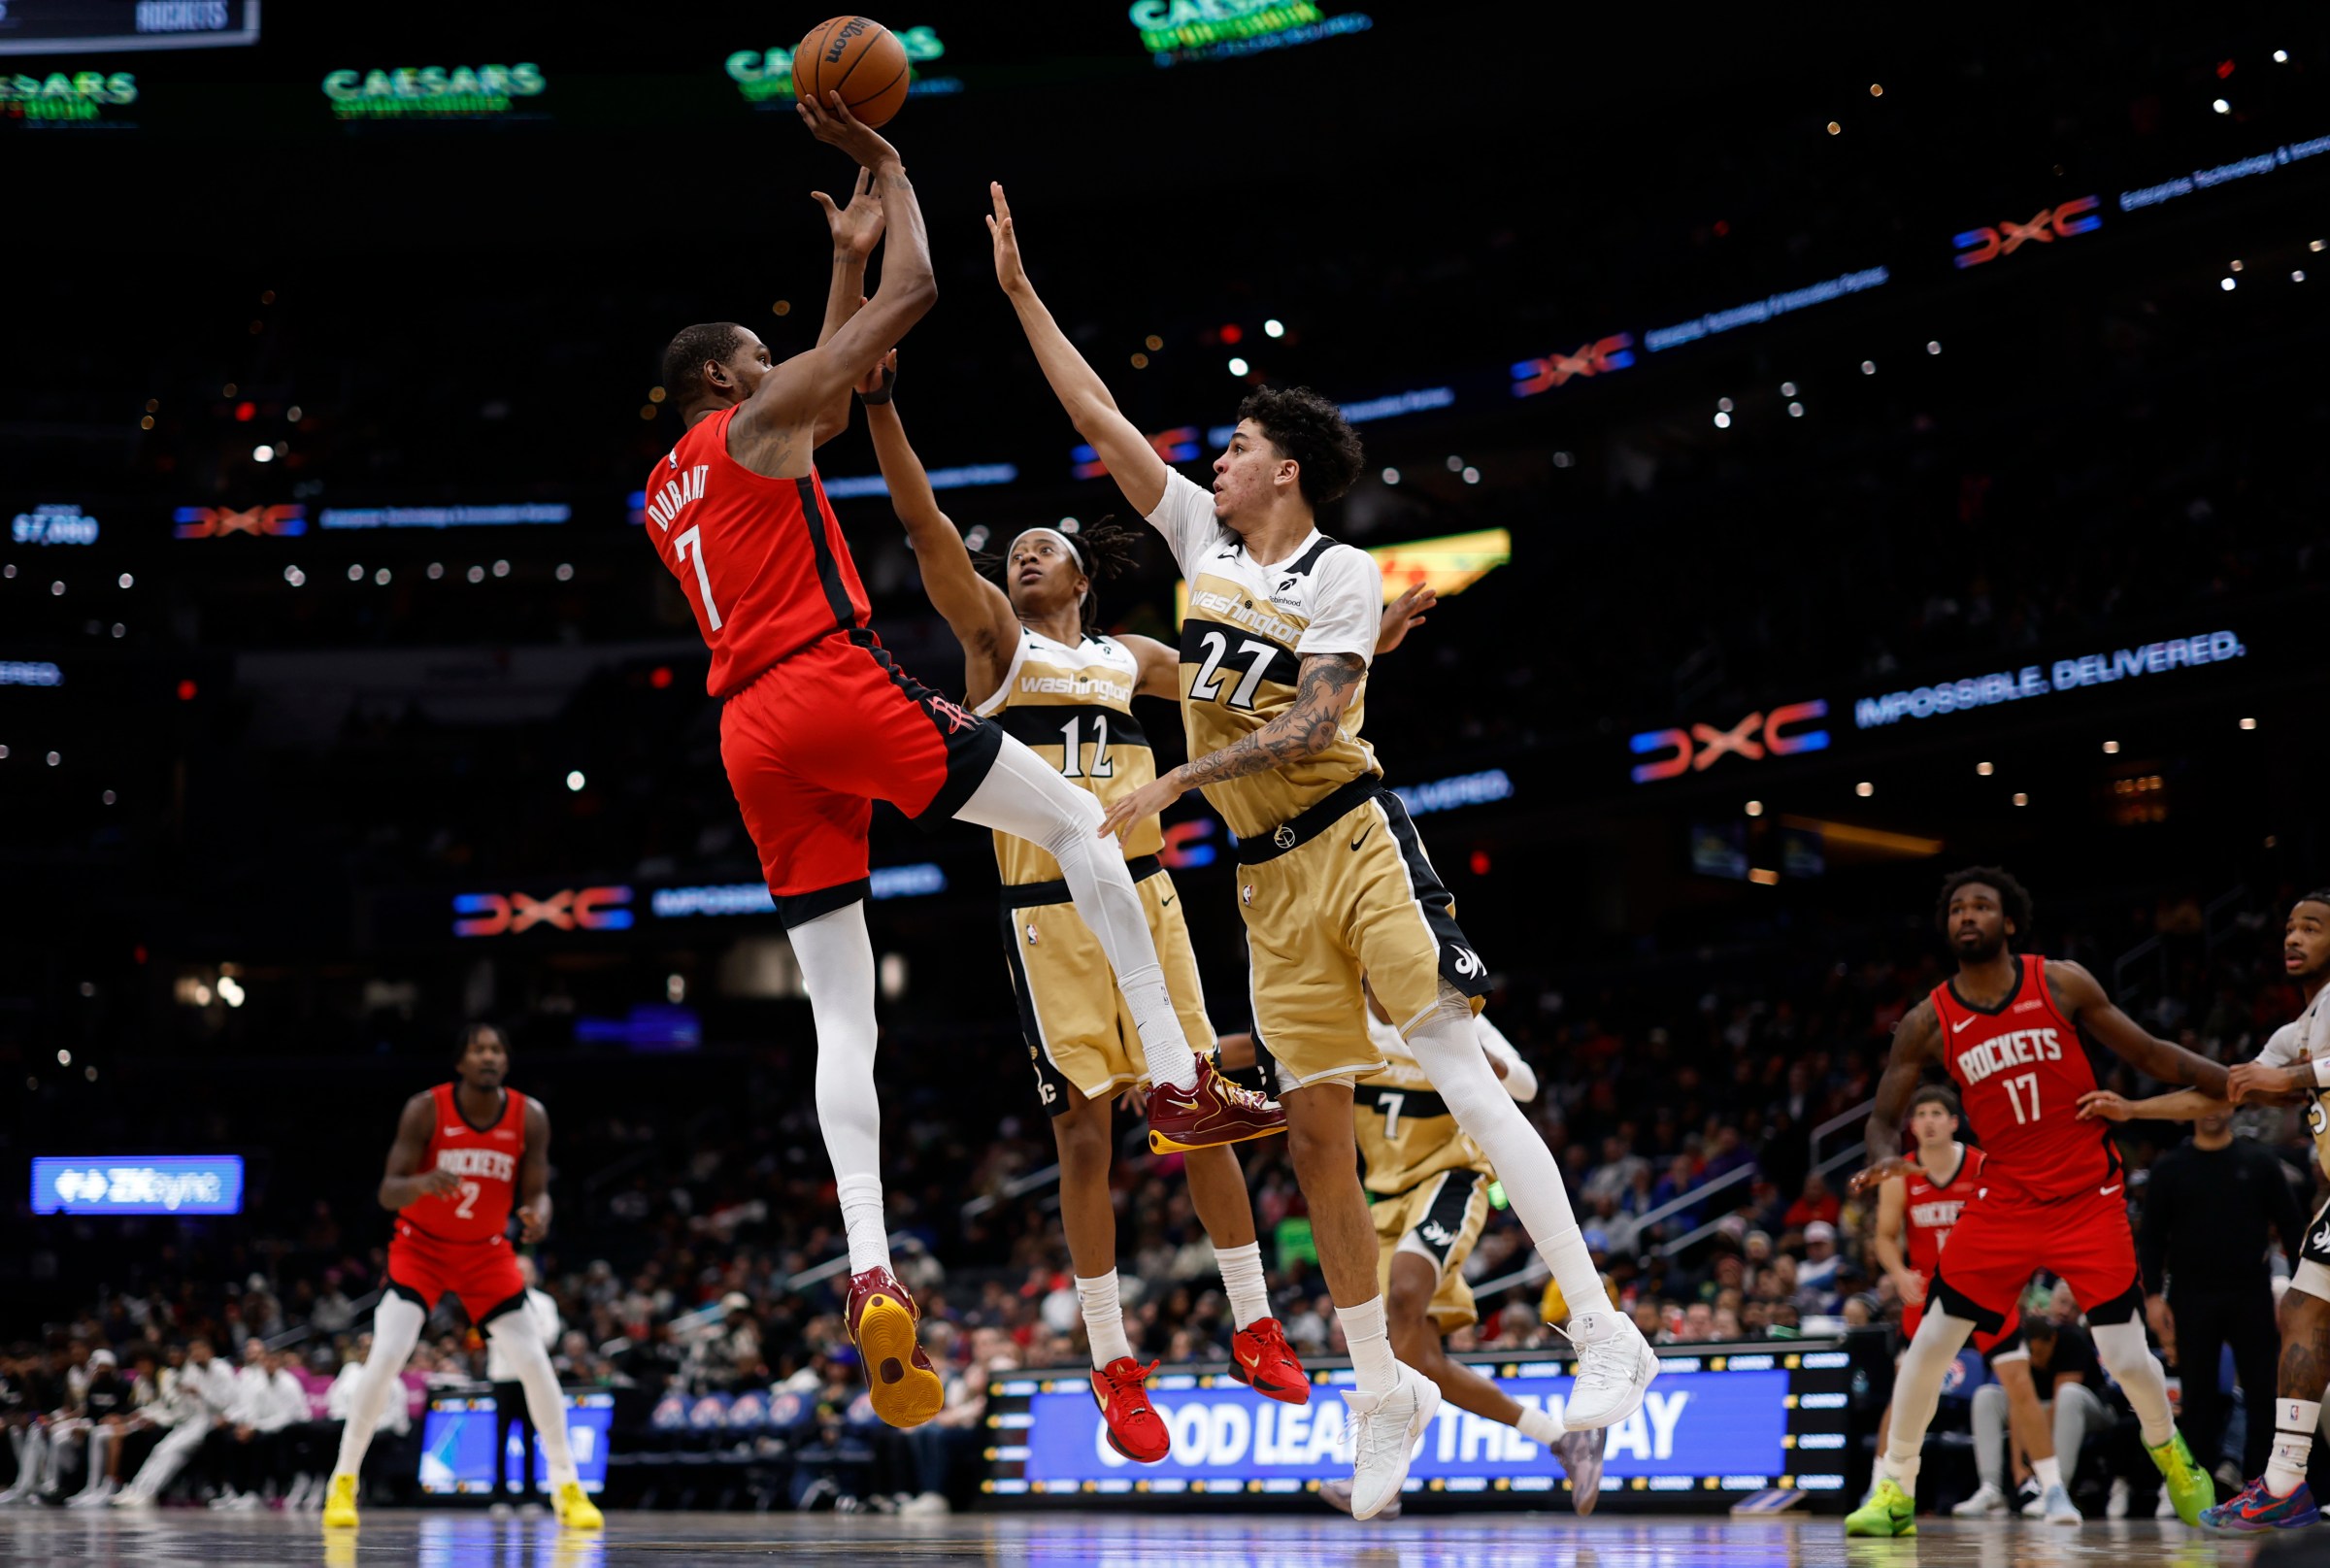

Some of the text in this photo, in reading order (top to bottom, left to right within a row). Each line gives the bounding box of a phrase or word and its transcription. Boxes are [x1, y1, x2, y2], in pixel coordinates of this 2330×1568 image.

[321, 61, 547, 101] CAESARS
[648, 464, 710, 533] DURANT
[674, 523, 722, 632] 7
[1190, 589, 1304, 646] washington
[1020, 673, 1130, 702] washington
[1188, 630, 1279, 711] 27
[2050, 629, 2247, 691] DELIVERED.
[1059, 715, 1114, 778] 12
[1957, 1027, 2063, 1086] ROCKETS
[1378, 1092, 1405, 1140] 7
[2002, 1071, 2042, 1125] 17
[454, 1181, 481, 1219] 2
[1910, 1199, 1966, 1228] ROCKE
